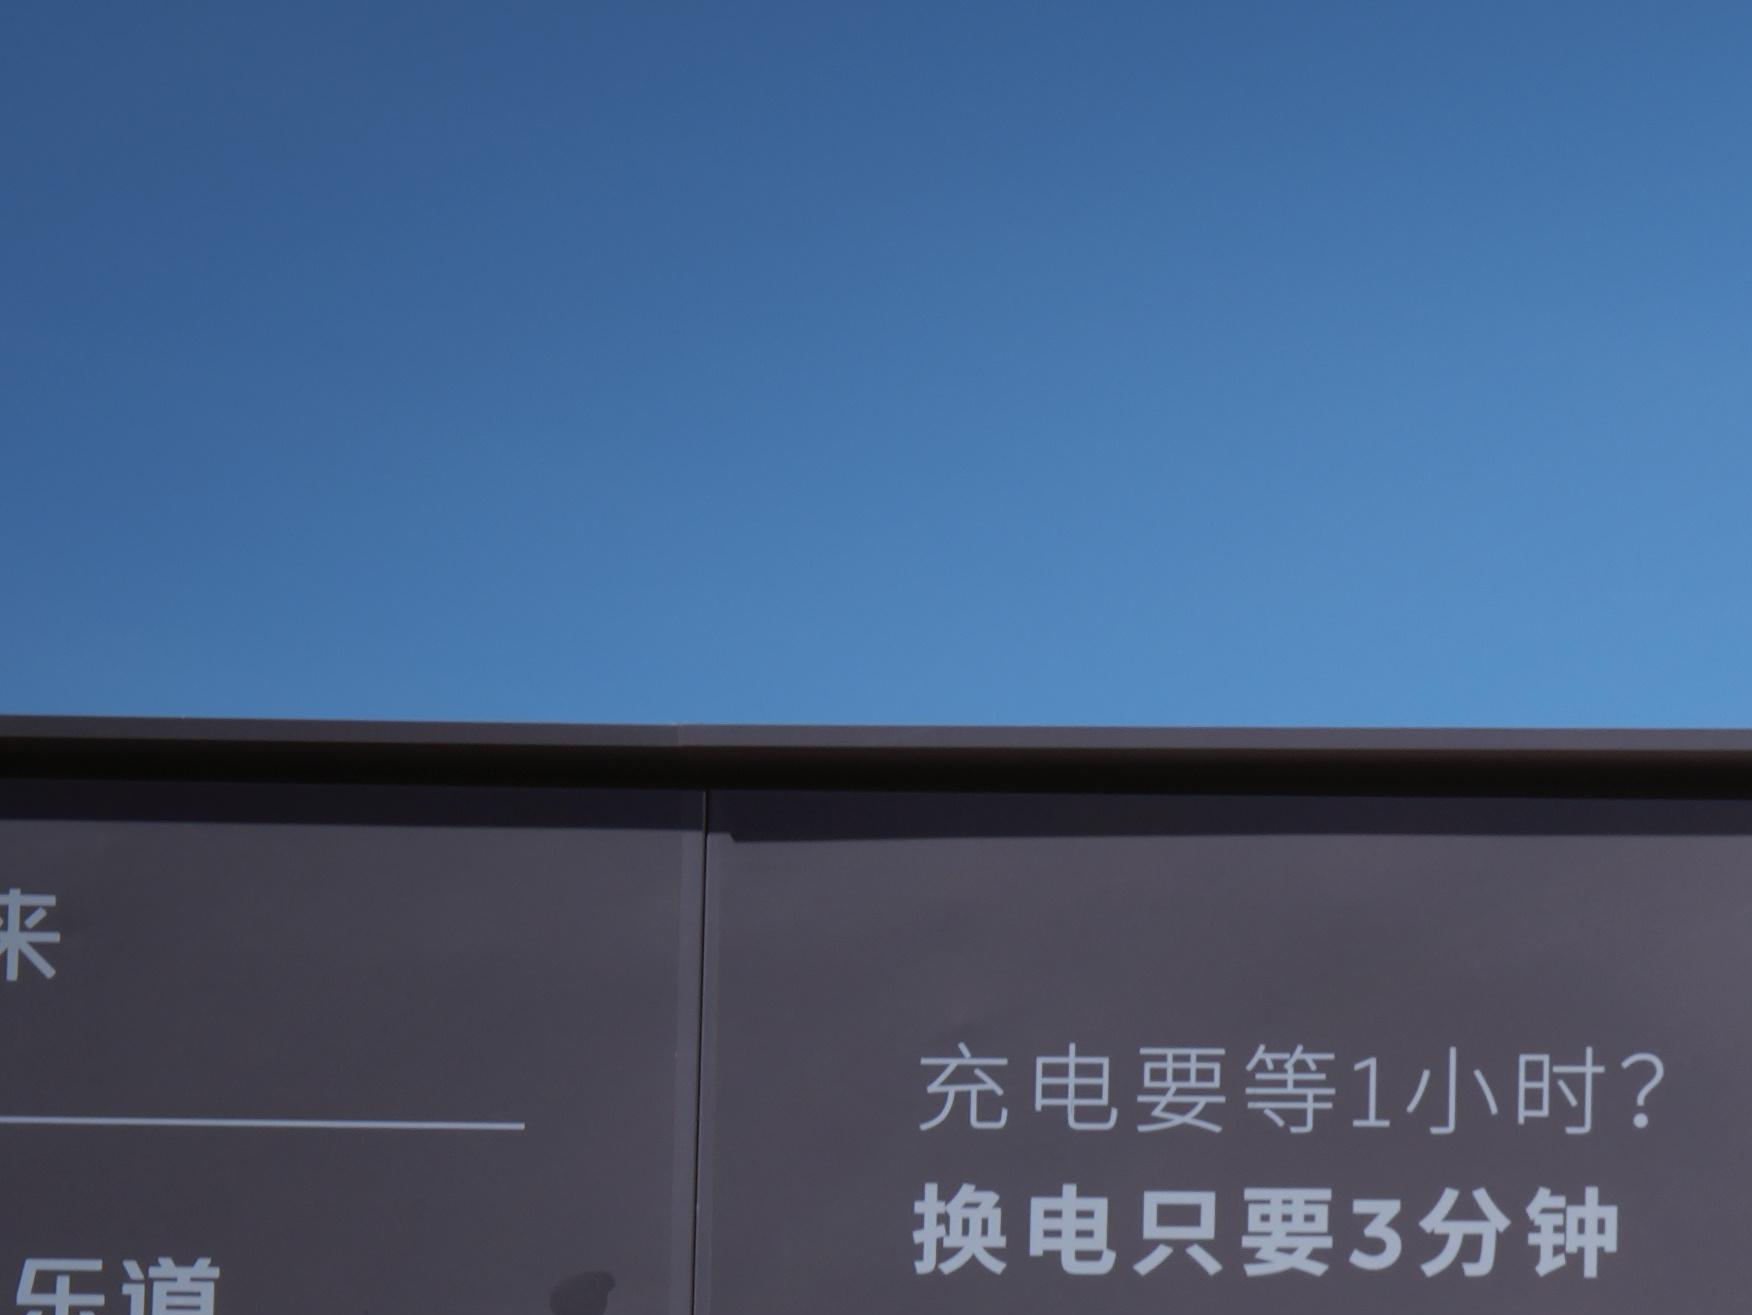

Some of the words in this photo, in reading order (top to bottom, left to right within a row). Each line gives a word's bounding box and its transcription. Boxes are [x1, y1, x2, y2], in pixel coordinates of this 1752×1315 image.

[920, 1043, 1664, 1134] 充电要等1小时？
[913, 1183, 1617, 1278] 换电只要3分钟
